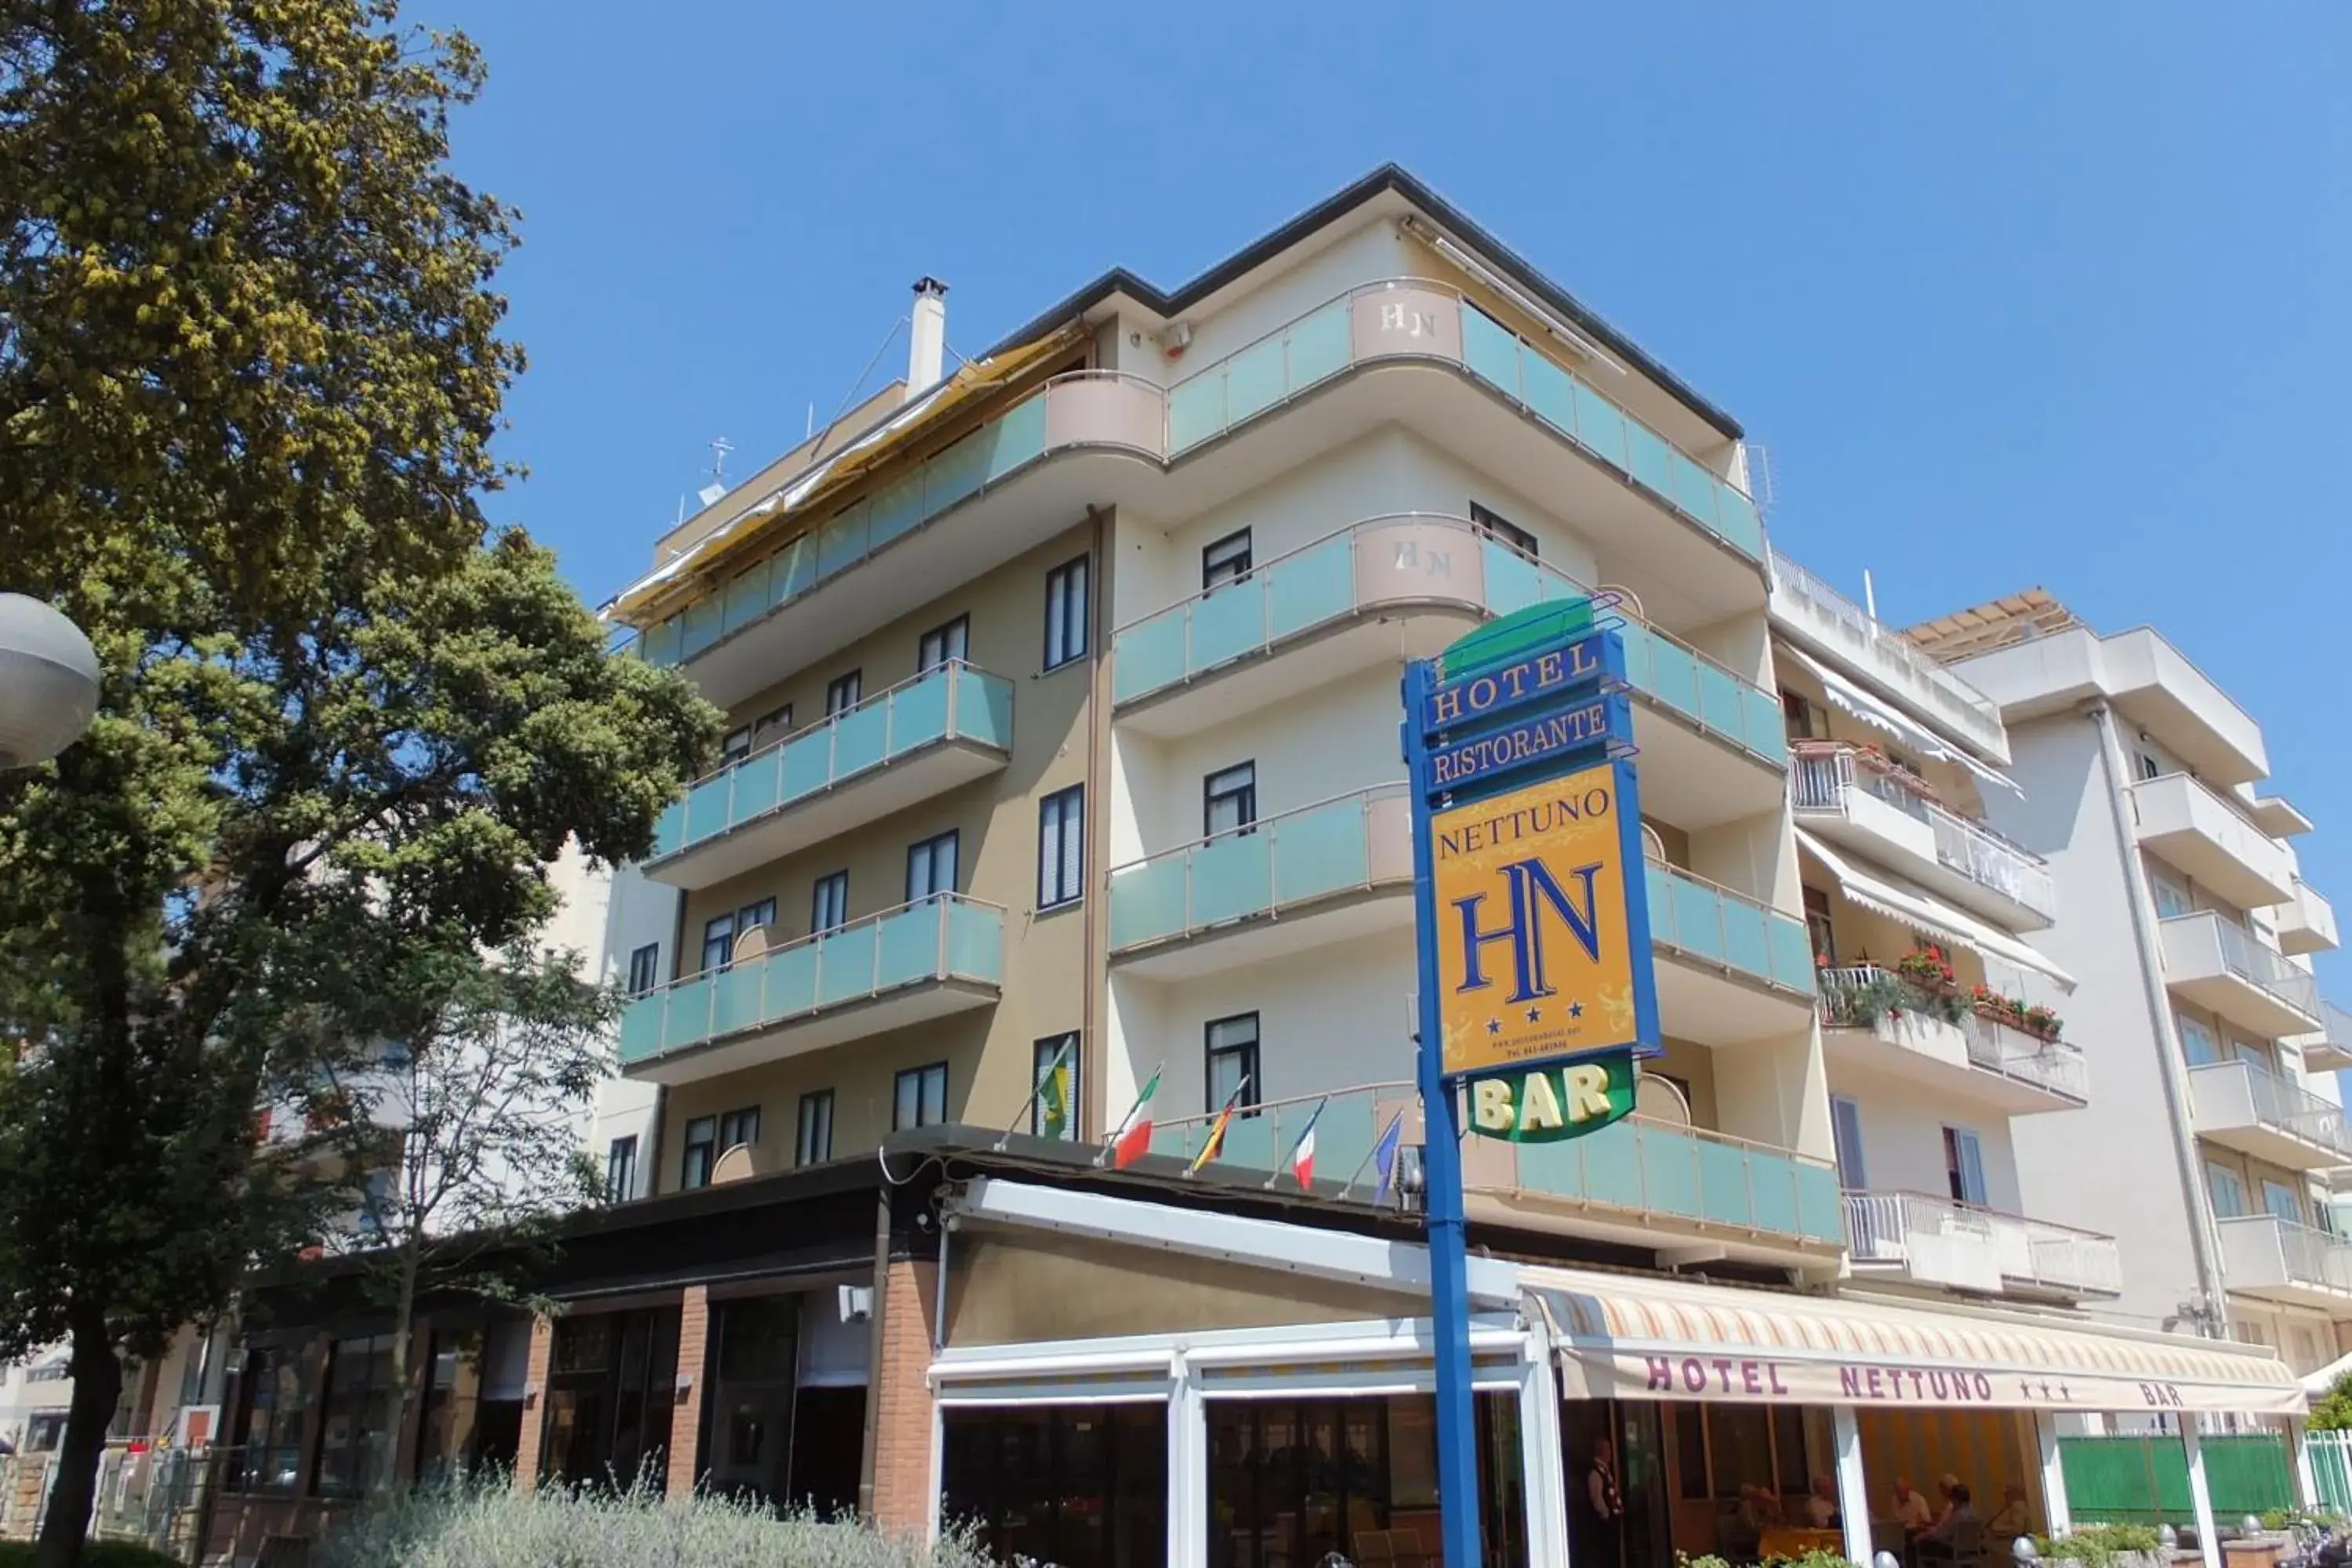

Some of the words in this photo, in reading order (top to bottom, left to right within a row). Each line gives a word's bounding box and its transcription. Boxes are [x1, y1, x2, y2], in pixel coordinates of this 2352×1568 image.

[1436, 643, 1597, 724] HOTEL
[1434, 706, 1606, 784] RISTORANTE
[1440, 788, 1610, 860] NETTUNO
[1451, 856, 1604, 1005] HN
[1475, 1063, 1612, 1131] BAR
[1646, 1356, 1788, 1395] HOTEL
[1840, 1367, 1992, 1401] NETTUNO
[2139, 1381, 2184, 1407] BAR
